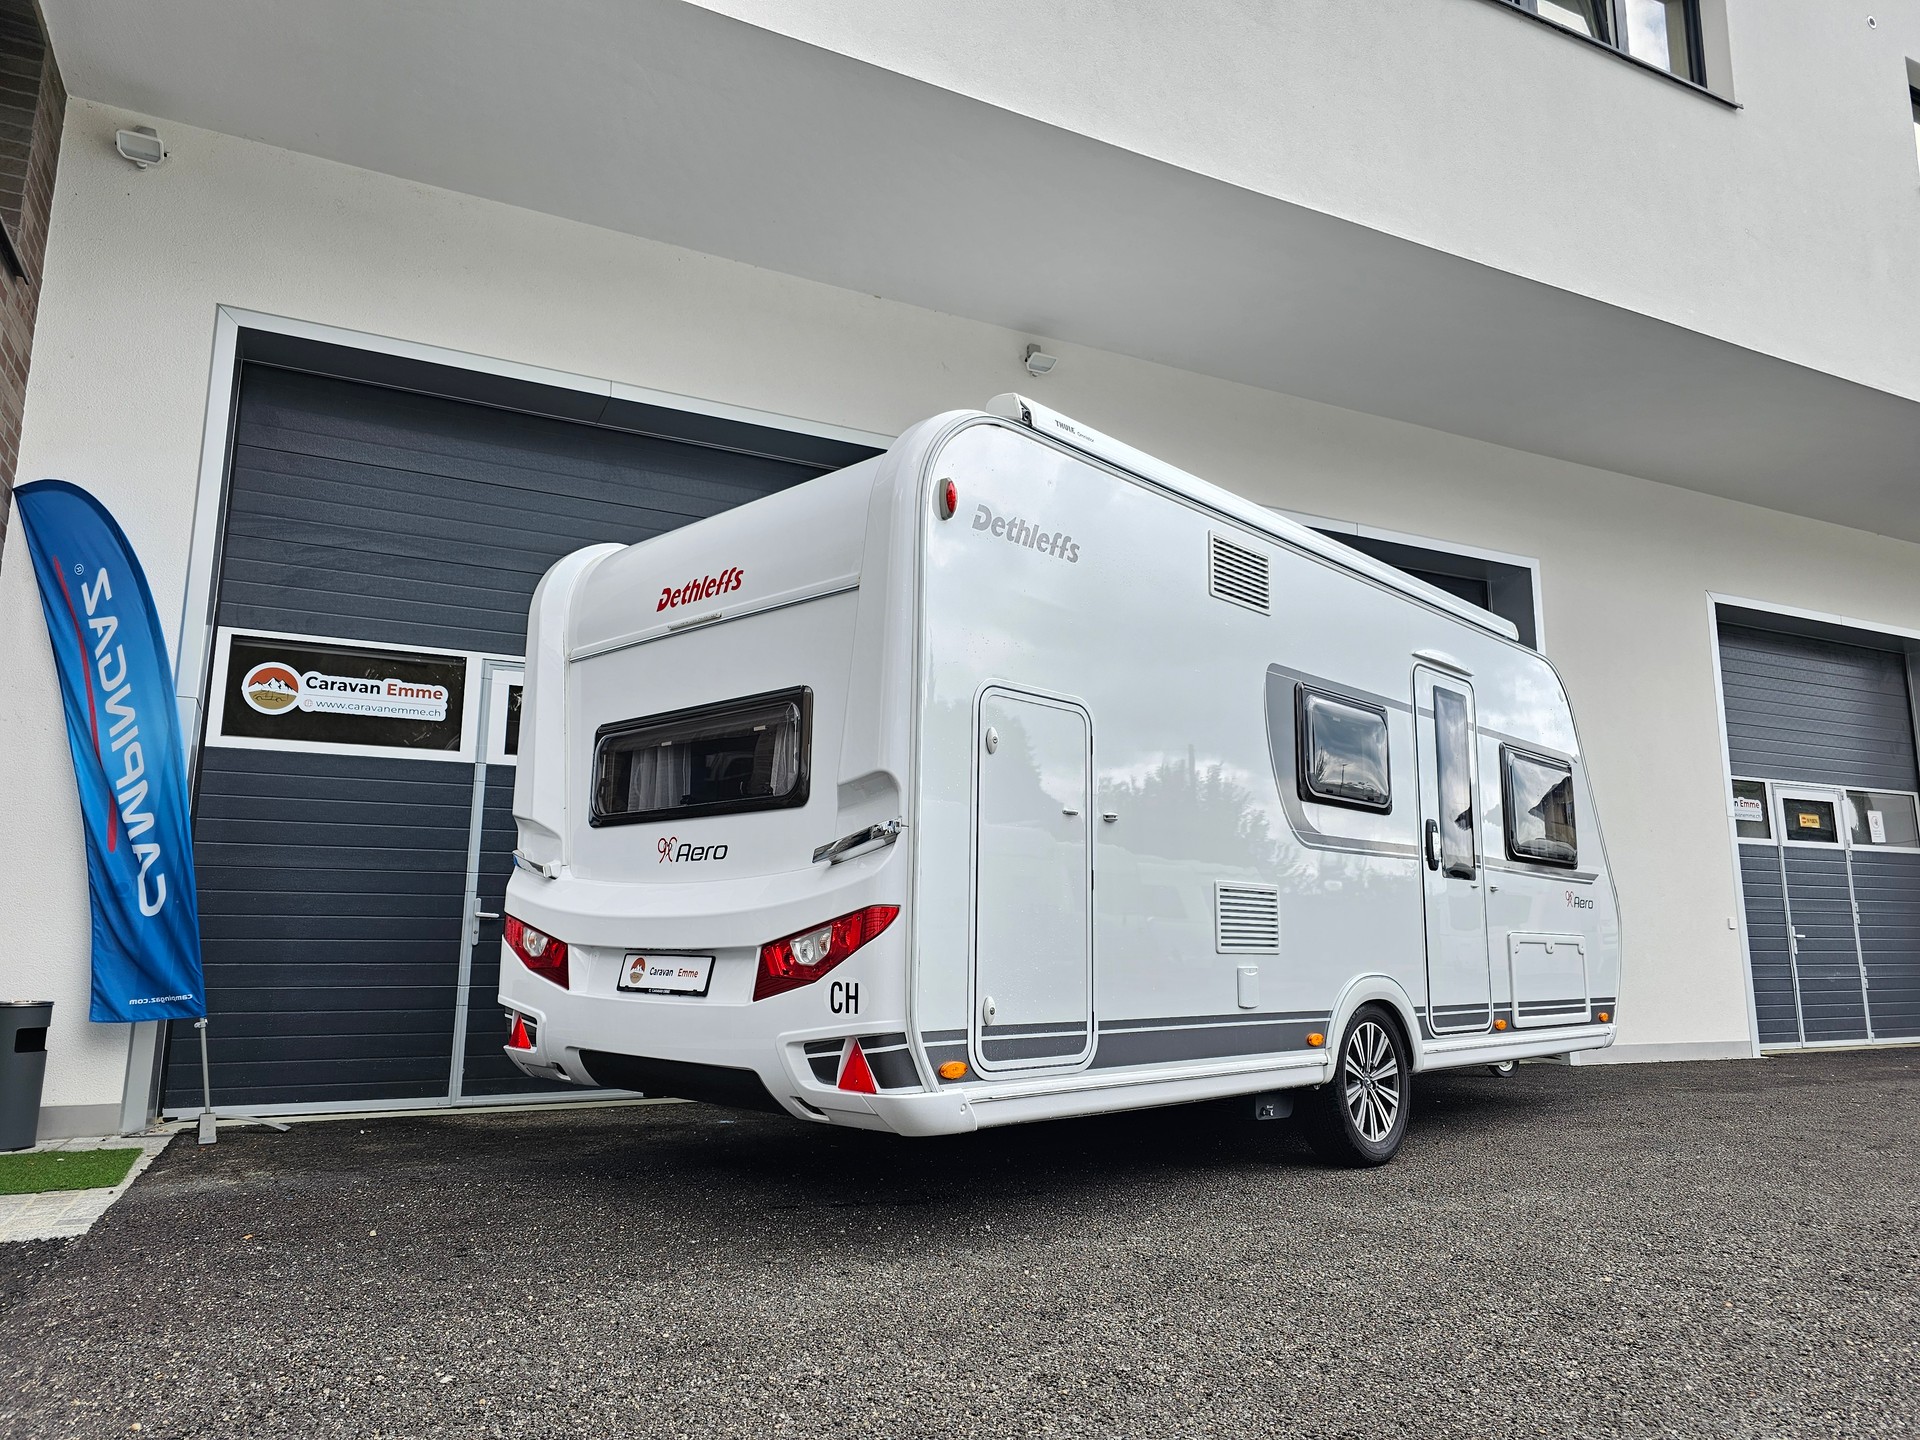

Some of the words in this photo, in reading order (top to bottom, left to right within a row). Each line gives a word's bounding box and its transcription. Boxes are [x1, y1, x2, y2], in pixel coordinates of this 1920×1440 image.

[972, 503, 1080, 563] Dethleffs
[656, 567, 744, 612] Dethleffs
[306, 676, 381, 695] Caravan
[387, 683, 443, 700] Emme
[316, 700, 441, 717] www.caravanemme.ch
[1740, 799, 1760, 808] Emme
[676, 843, 728, 862] Aero
[1574, 896, 1594, 909] Aero
[649, 966, 674, 977] Caravan
[678, 968, 699, 978] Emme
[830, 981, 859, 1014] CH
